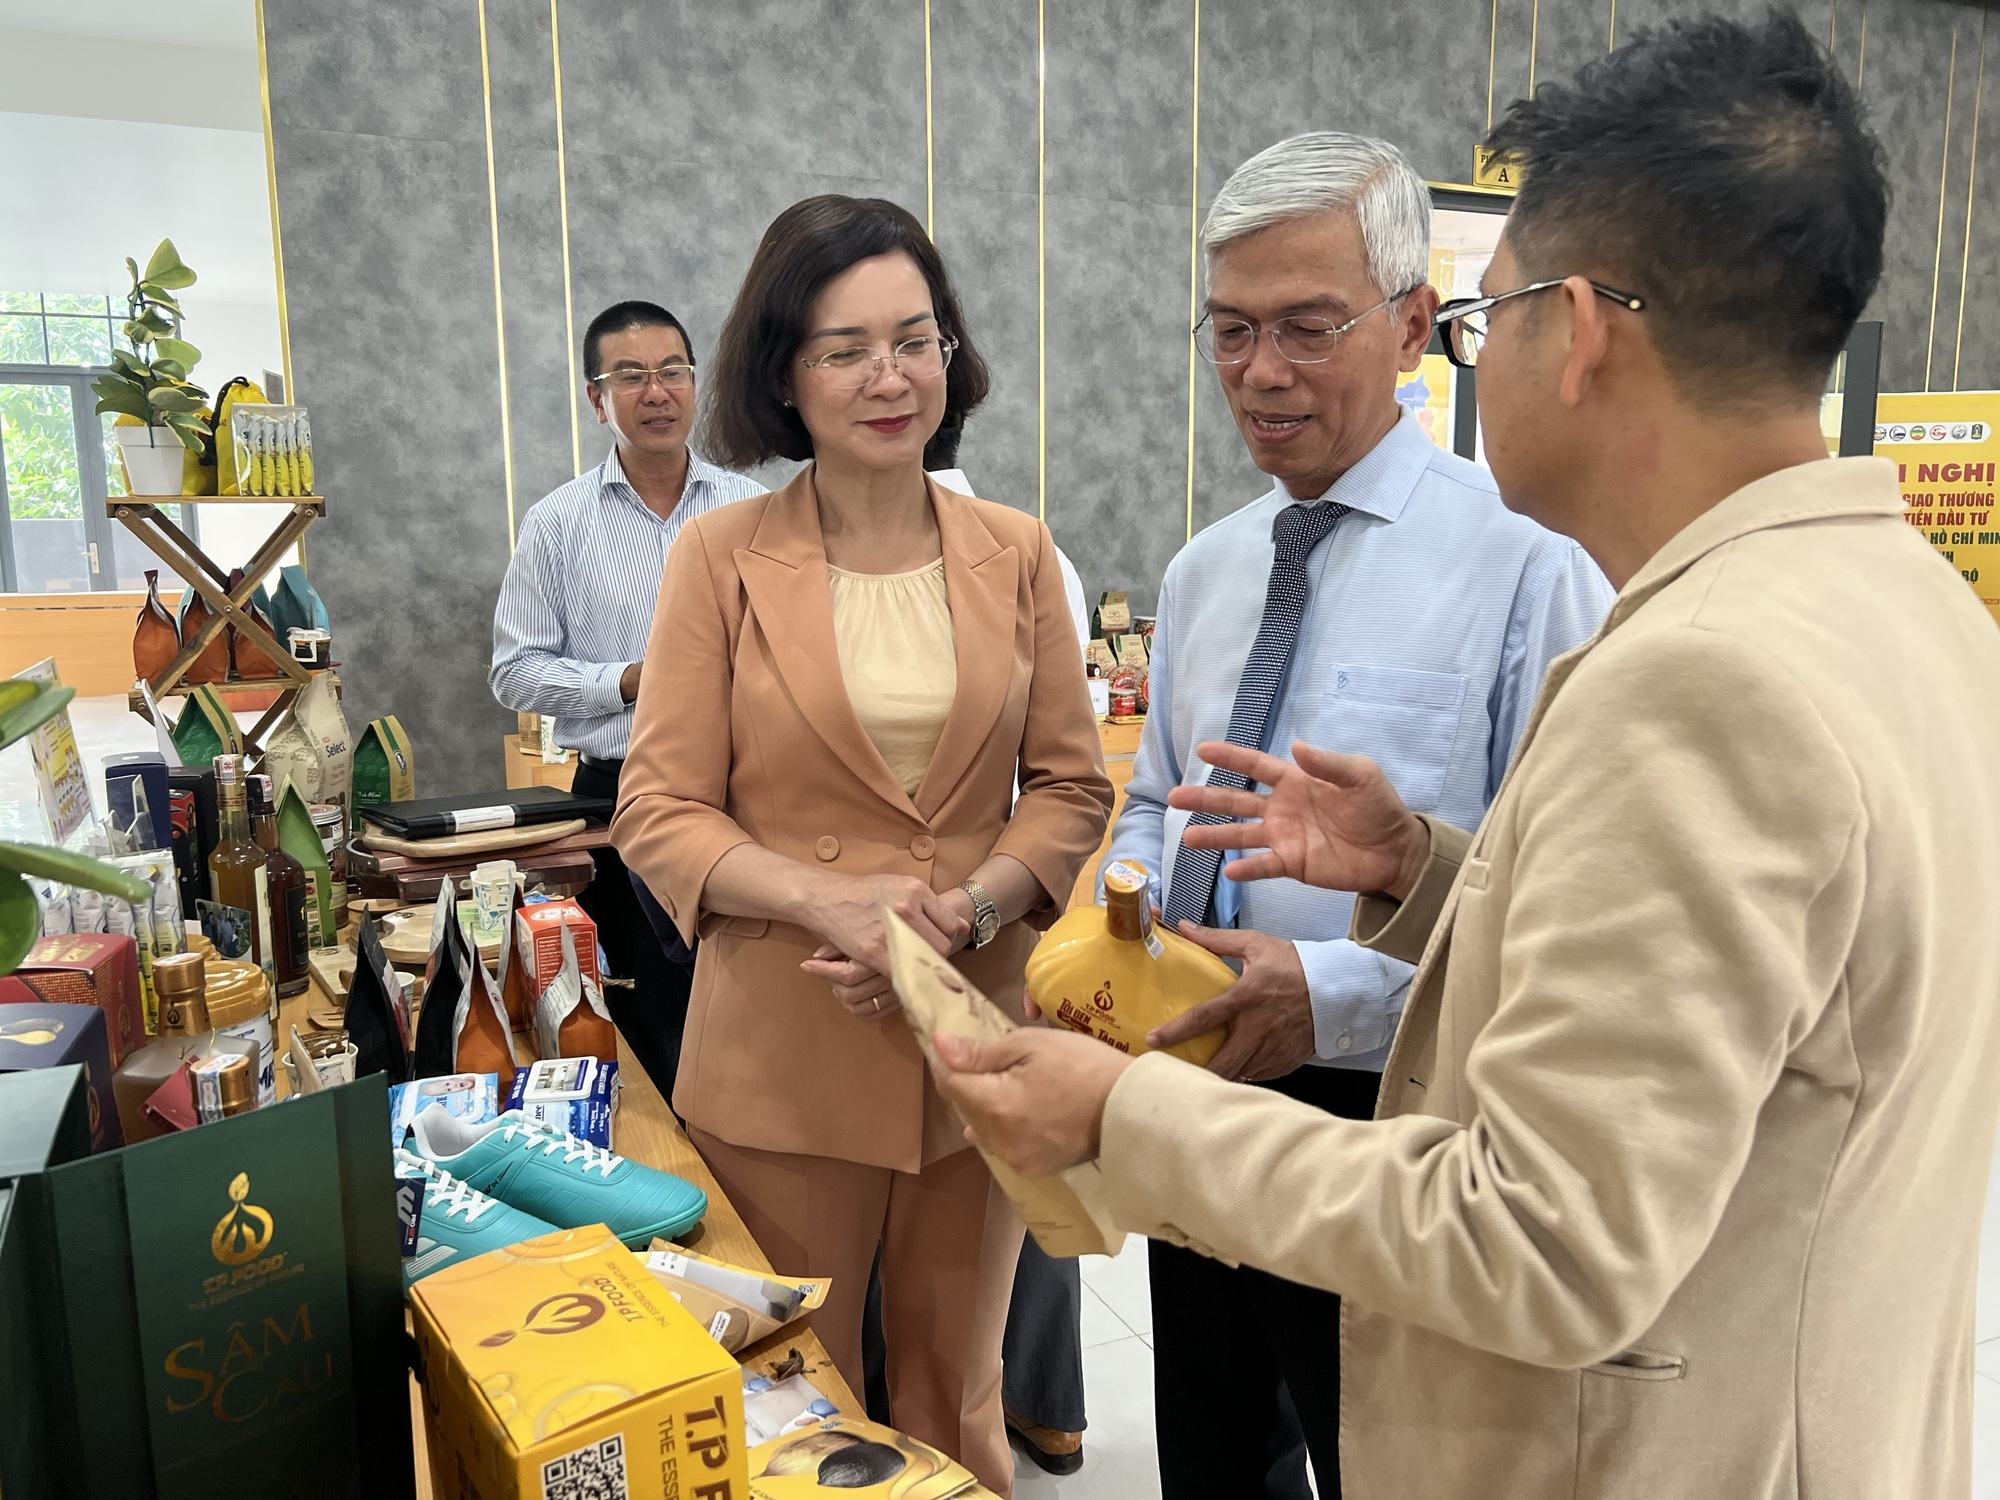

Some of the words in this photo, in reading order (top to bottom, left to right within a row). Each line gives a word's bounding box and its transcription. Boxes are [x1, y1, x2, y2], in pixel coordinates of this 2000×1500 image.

[1498, 168, 1509, 182] A
[1918, 463, 1995, 487] NGHỊ
[1939, 492, 1995, 507] THƯƠNG
[1904, 509, 1932, 526] TIẾN
[1937, 508, 1965, 526] ĐẦU
[1970, 511, 1990, 526] TƯ
[1930, 528, 1948, 545] HỒ
[1952, 530, 1974, 545] CHÍ
[325, 741, 347, 758] Select
[1095, 1009, 1115, 1023] FOOD
[231, 1253, 285, 1285] FOOD
[594, 1277, 634, 1307] FOOD
[164, 1302, 315, 1414] SÂM
[658, 1414, 675, 1455] THE
[685, 1394, 729, 1472] T.P
